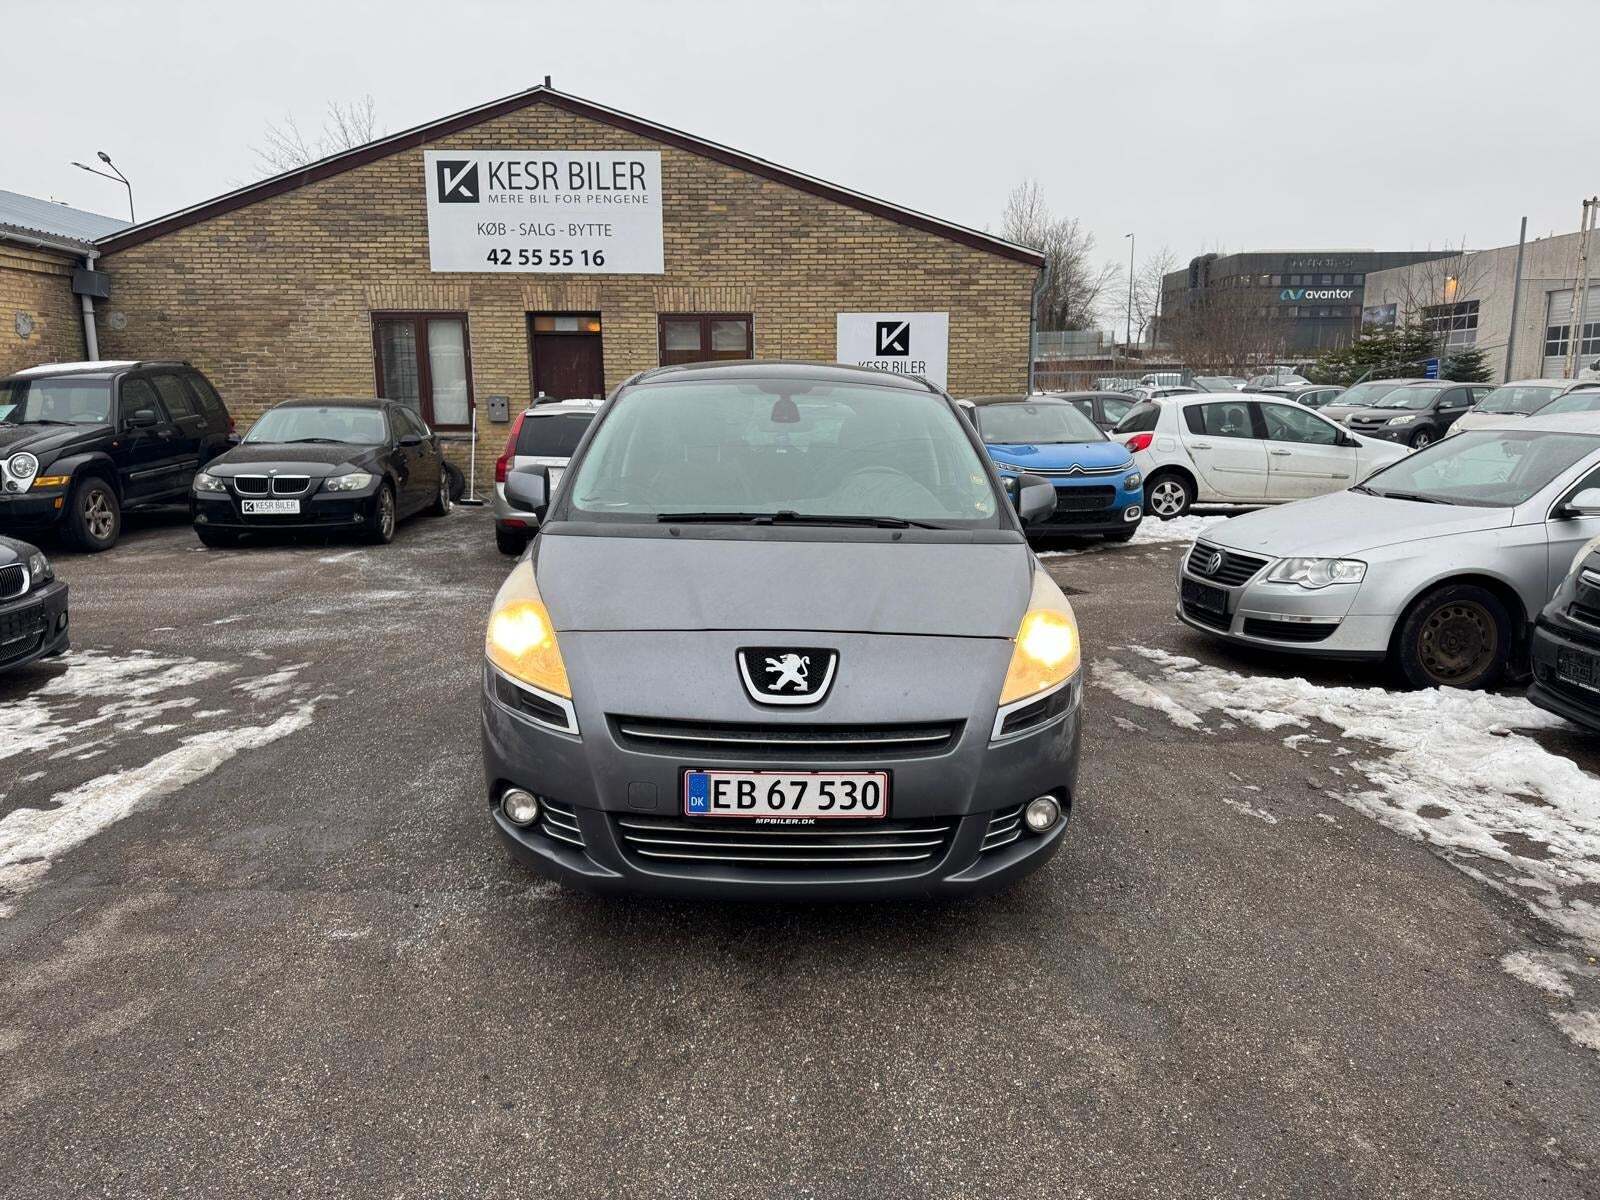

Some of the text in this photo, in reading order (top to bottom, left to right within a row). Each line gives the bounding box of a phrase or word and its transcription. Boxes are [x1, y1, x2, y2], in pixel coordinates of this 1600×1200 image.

[488, 161, 646, 191] KESR BILER
[488, 194, 649, 204] MERE BIL FOR PENGENE
[477, 222, 507, 236] KØB
[519, 223, 556, 236] SALG
[568, 223, 613, 237] BYTTE
[486, 248, 605, 267] 42 55 55 16
[1305, 288, 1354, 299] avantor
[892, 361, 926, 374] BILER
[255, 501, 296, 510] KESR BILER
[690, 796, 704, 807] DK
[713, 779, 880, 811] EB 67 530
